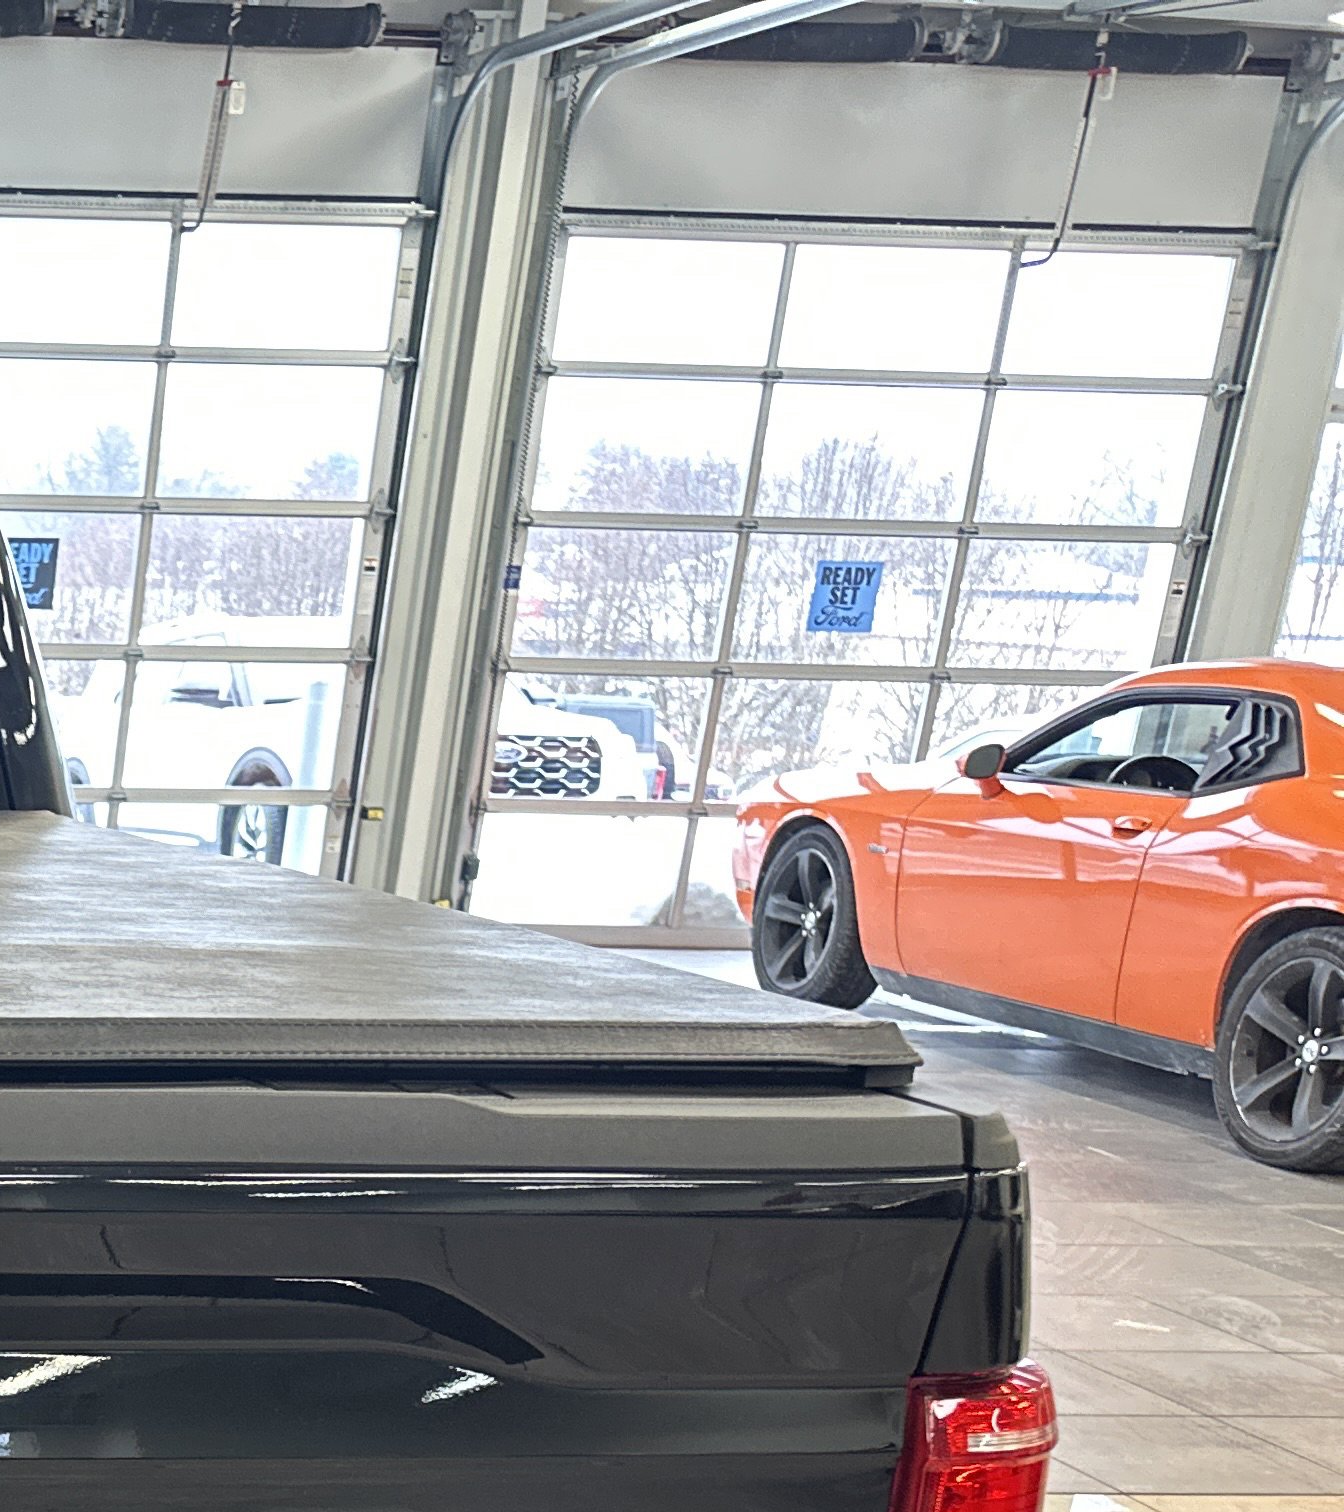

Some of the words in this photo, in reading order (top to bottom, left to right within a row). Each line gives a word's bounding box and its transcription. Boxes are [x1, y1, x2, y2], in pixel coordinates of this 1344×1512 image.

[10, 543, 54, 564] EADY
[18, 563, 40, 583] ET
[820, 567, 876, 586] READY
[828, 586, 860, 605] SET
[814, 605, 869, 627] Ford
